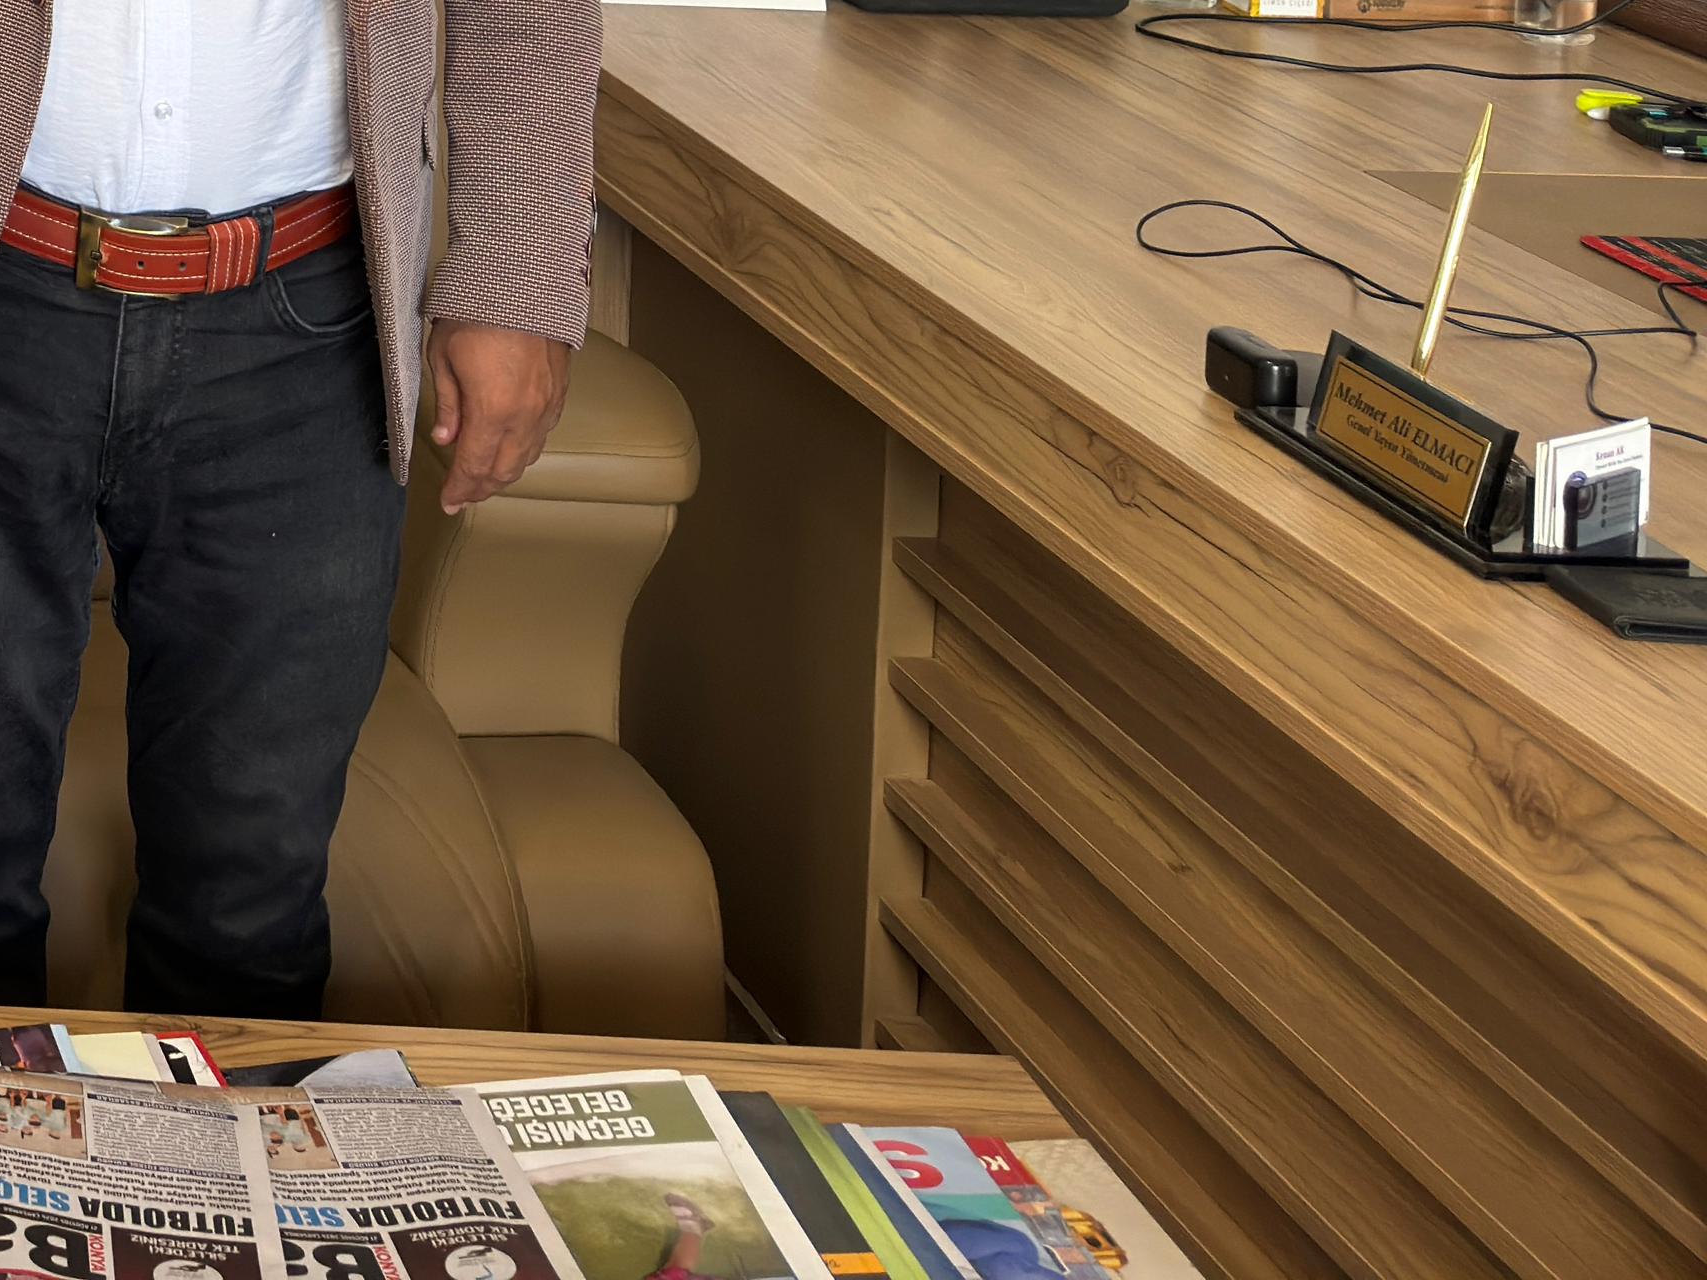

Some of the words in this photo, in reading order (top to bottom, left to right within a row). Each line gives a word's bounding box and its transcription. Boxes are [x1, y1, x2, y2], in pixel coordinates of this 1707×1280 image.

[1335, 382, 1388, 424] Mehmet
[1387, 416, 1412, 438] Ali
[1411, 426, 1475, 476] ELMACI
[481, 1090, 632, 1123] GELECEĞ
[515, 1115, 655, 1148] GEÇMİŞİ
[78, 1196, 254, 1237] FUTBOLDA
[347, 1197, 525, 1228] FUTBOLDA
[88, 1234, 106, 1272] KONYA
[131, 1235, 207, 1251] ADRESİNİZ
[150, 1245, 227, 1261] SİLLE'DEKİ
[212, 1243, 240, 1254] TEK
